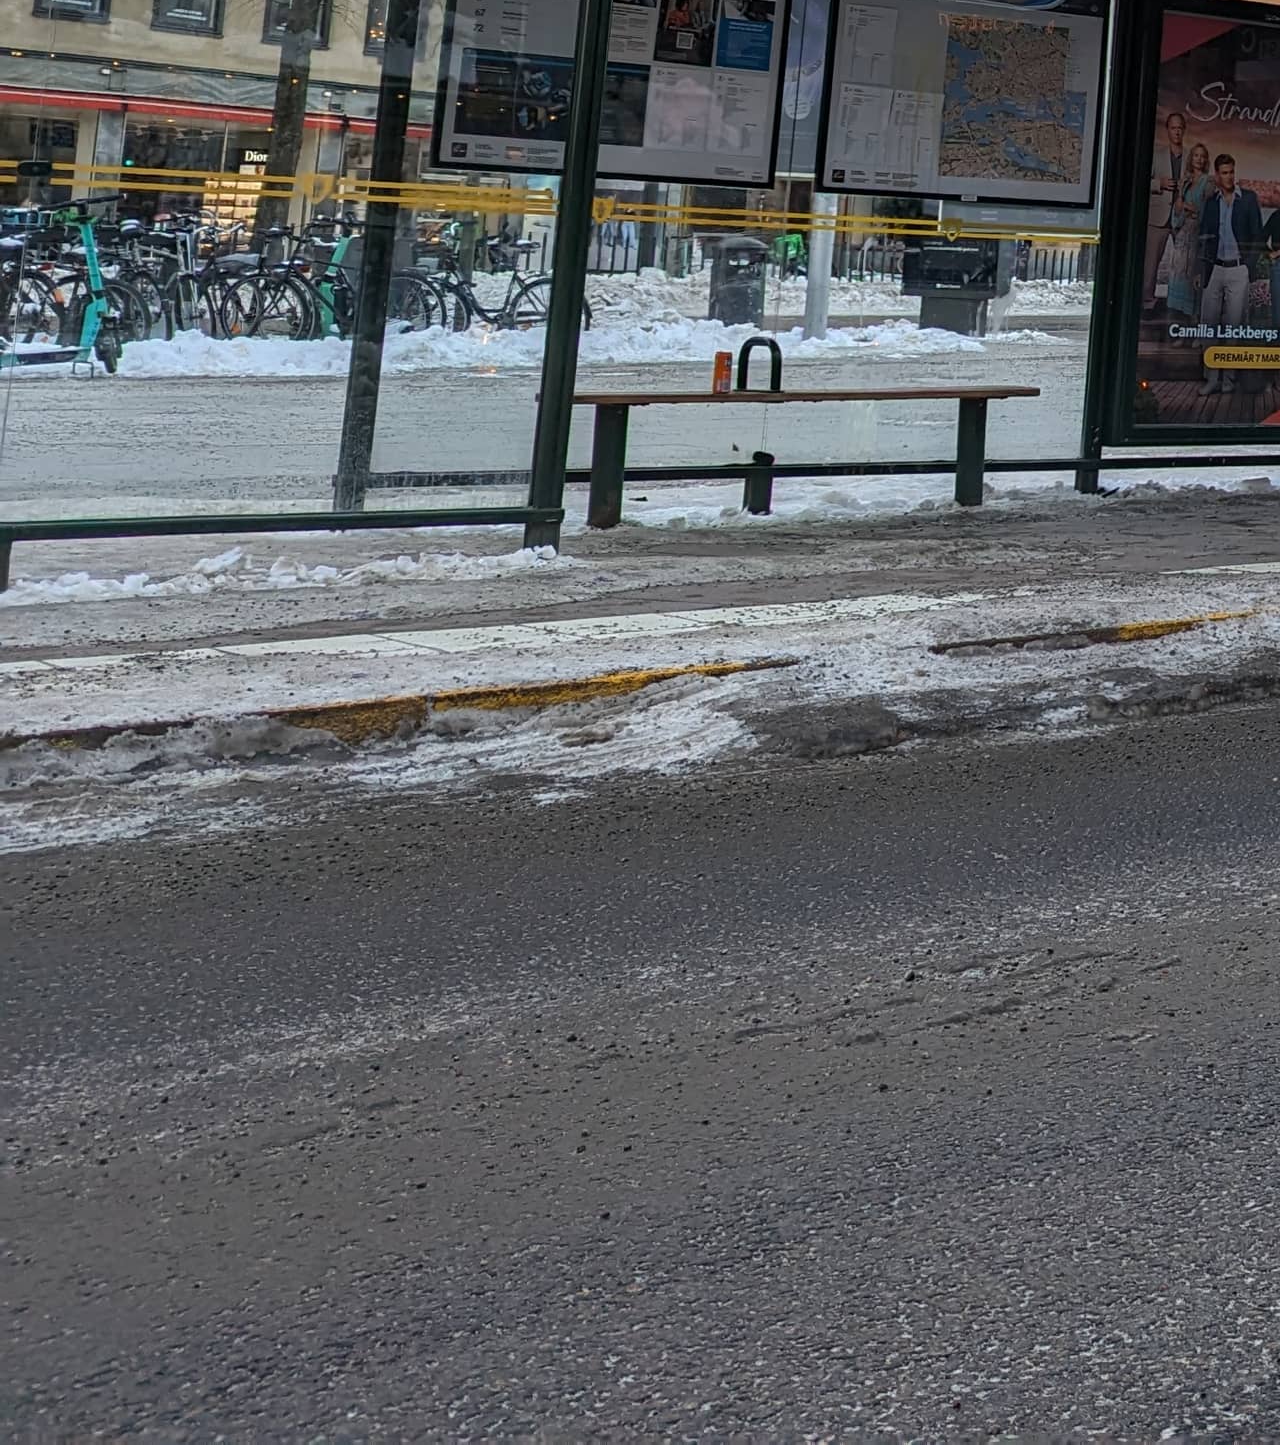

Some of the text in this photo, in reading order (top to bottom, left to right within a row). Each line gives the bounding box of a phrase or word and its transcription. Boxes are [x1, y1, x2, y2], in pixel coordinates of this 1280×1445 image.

[244, 150, 268, 162] Dior
[1168, 323, 1214, 338] Camilla
[1216, 324, 1278, 343] Läckbergs
[1255, 354, 1260, 363] 7
